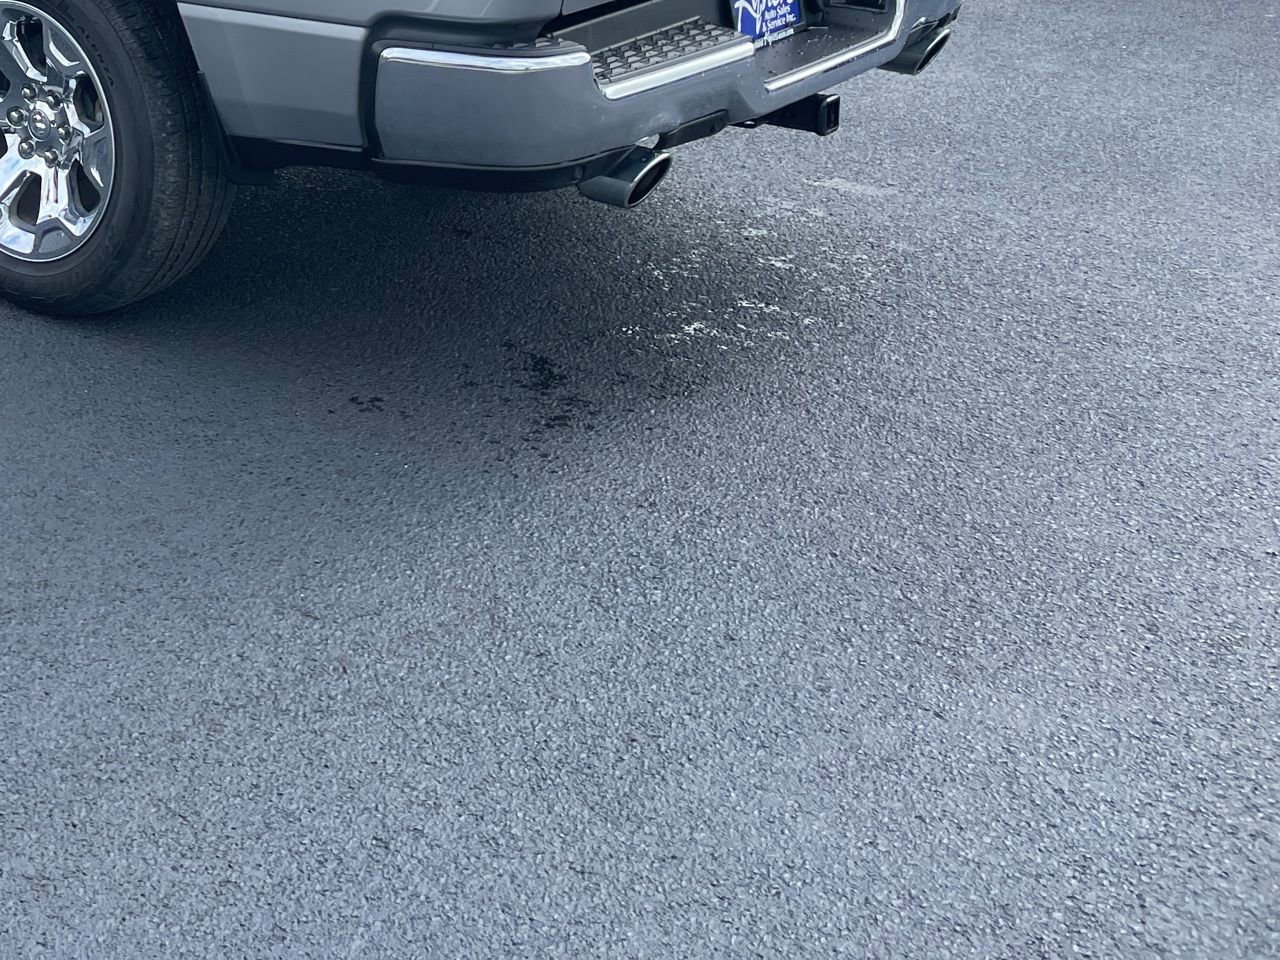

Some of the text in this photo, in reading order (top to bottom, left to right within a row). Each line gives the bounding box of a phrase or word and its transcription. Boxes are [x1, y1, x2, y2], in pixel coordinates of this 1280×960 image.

[765, 4, 790, 21] Auto Sales
[767, 17, 785, 29] Service
